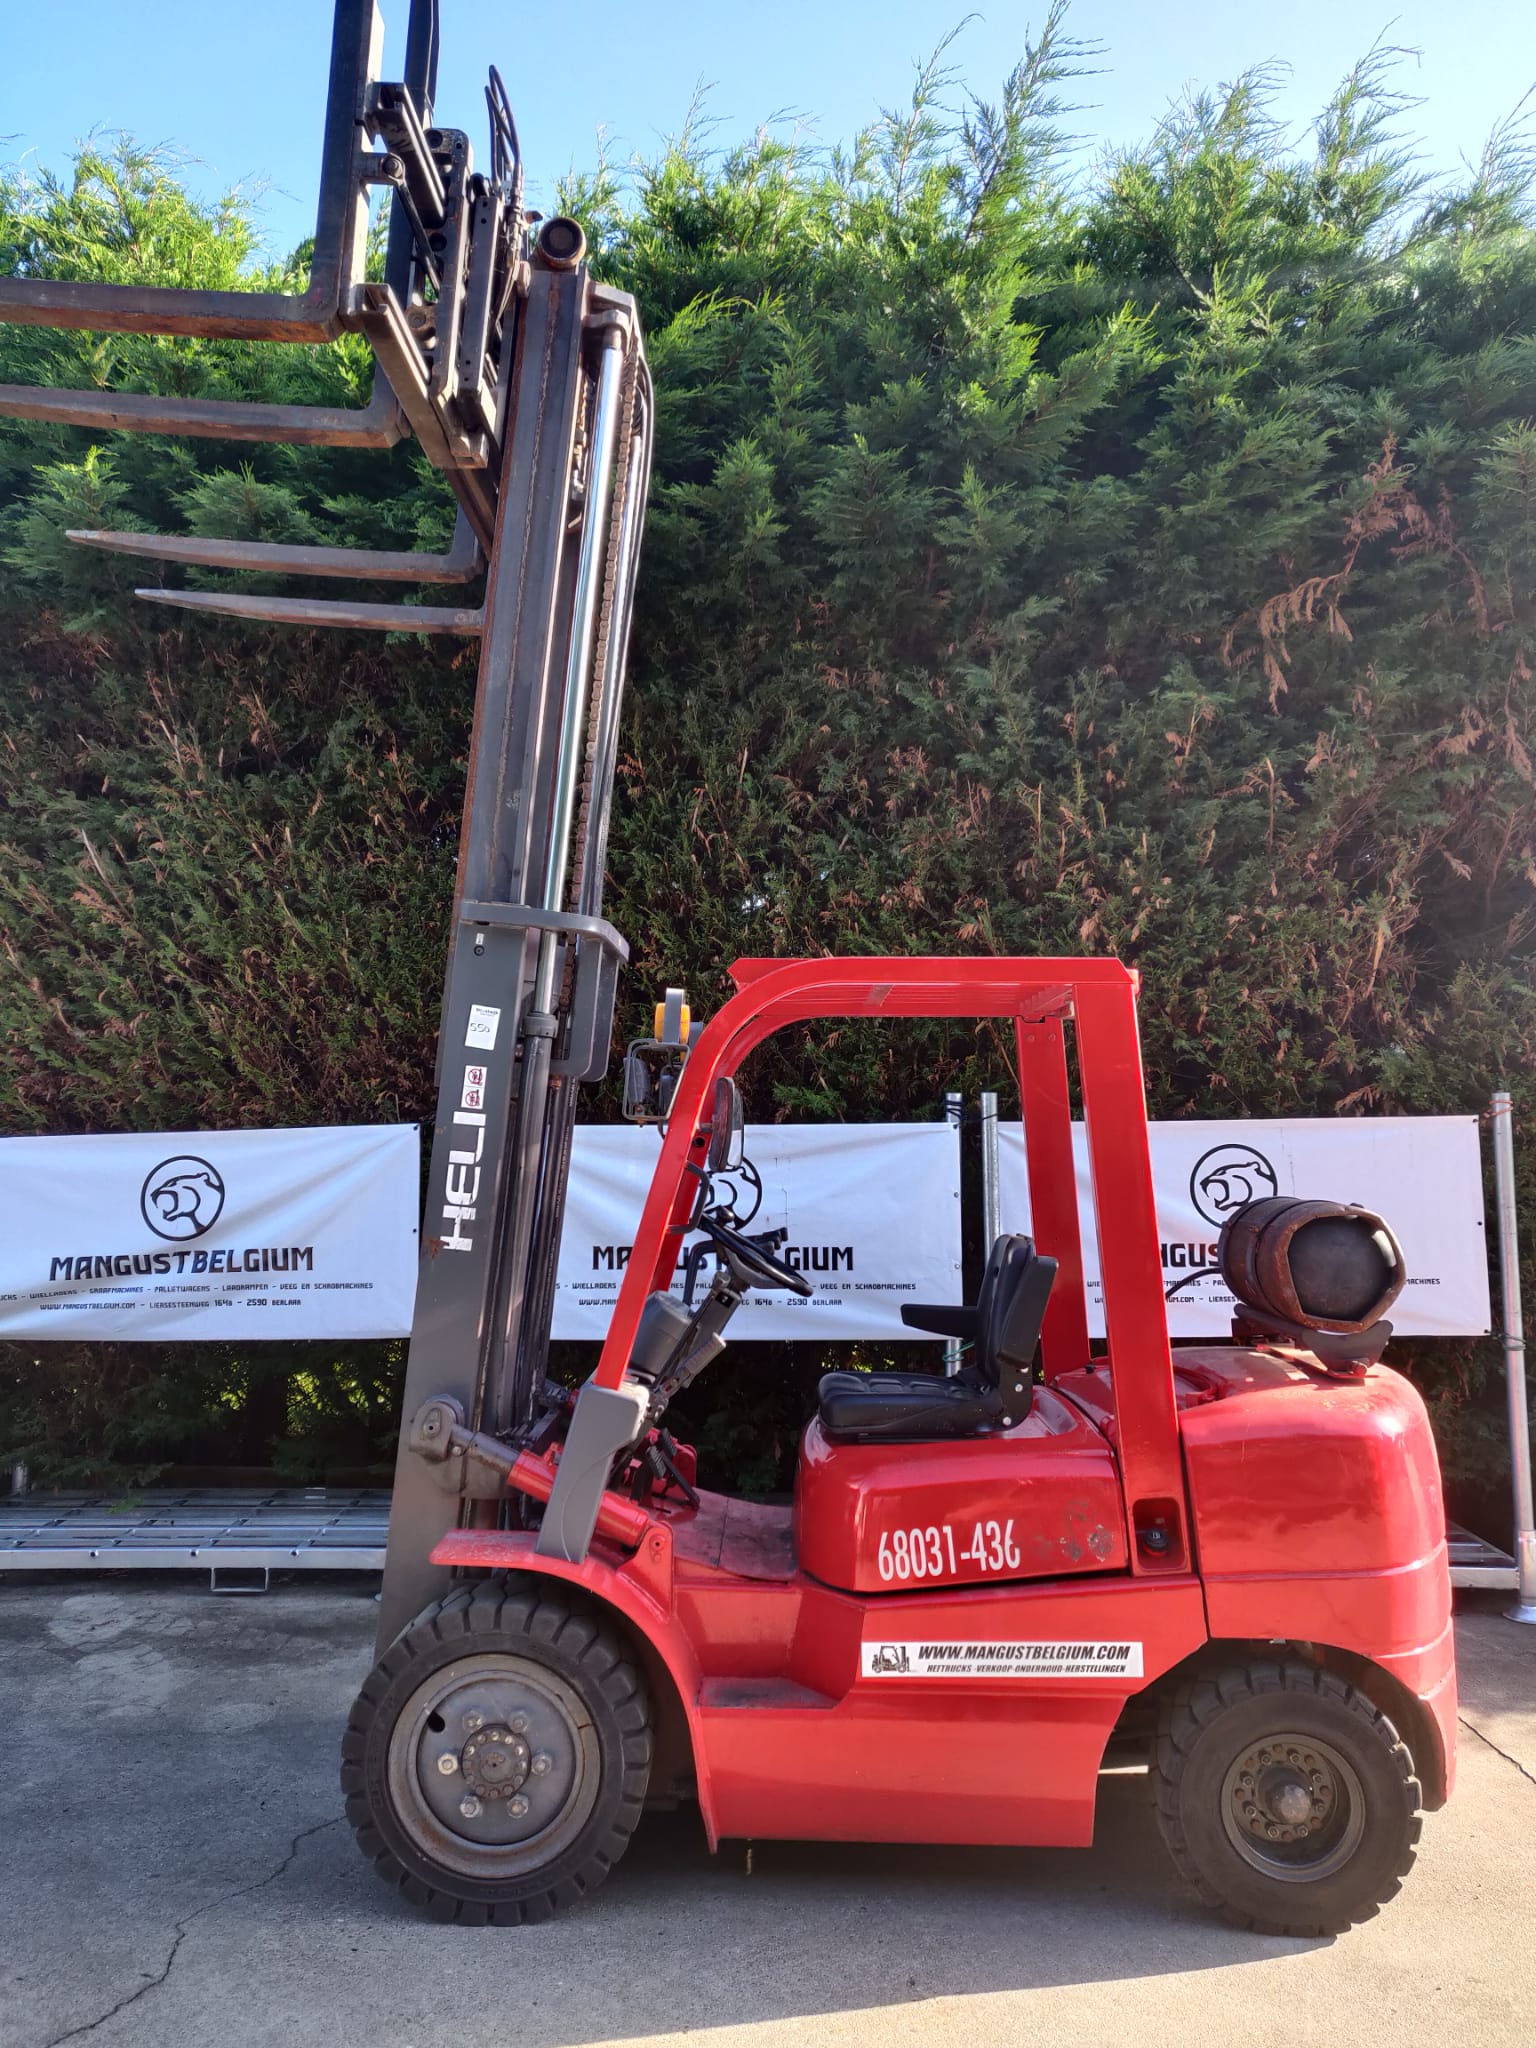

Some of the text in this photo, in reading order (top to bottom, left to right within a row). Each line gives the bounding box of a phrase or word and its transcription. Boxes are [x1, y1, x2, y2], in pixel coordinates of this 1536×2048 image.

[440, 1111, 487, 1252] HELI
[49, 1246, 315, 1282] MANGUSTBELGIUM
[154, 1285, 210, 1293] PALLETWAGENS
[222, 1283, 269, 1291] LAADRAMPEN
[314, 1282, 374, 1290] SCHROBMACHINES
[247, 1298, 268, 1306] 2590
[787, 1298, 808, 1306] 2590
[878, 1519, 1021, 1582] 68031-436
[918, 1644, 1131, 1661] WWW.MANGUSTBELGIUM.COM
